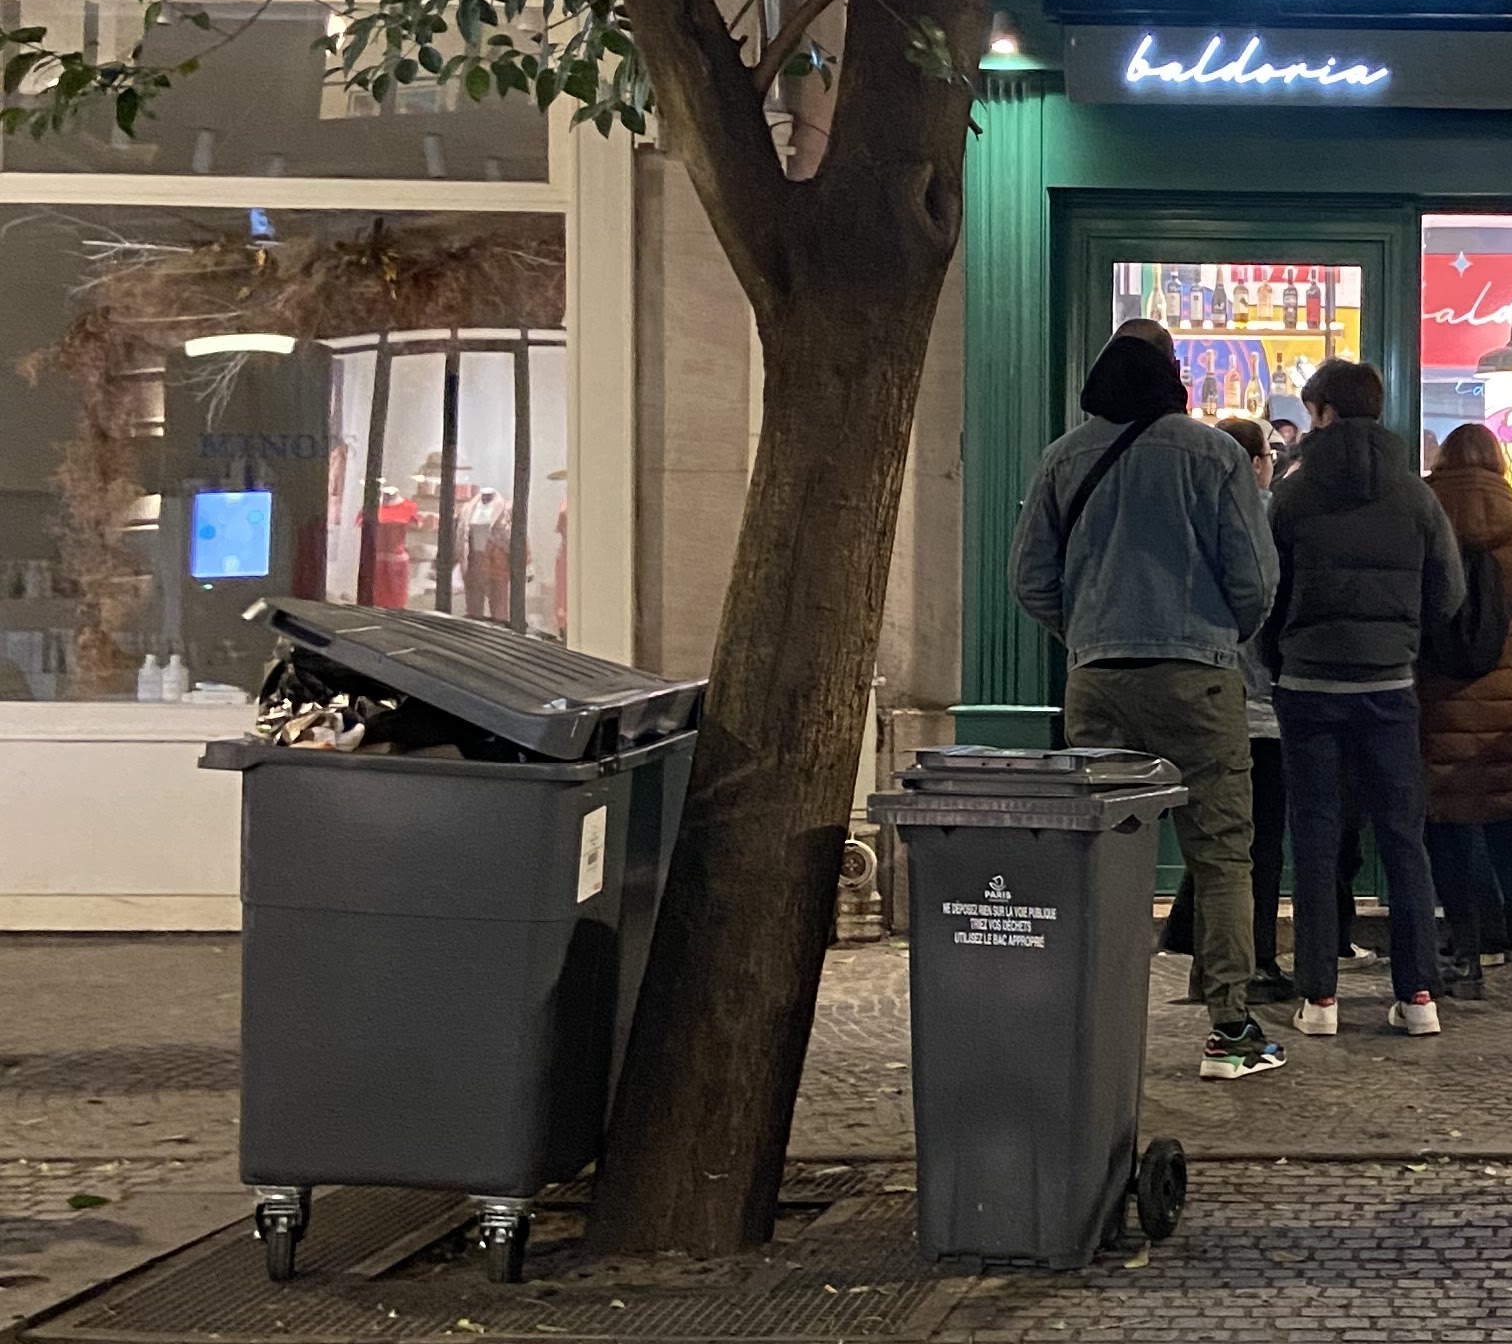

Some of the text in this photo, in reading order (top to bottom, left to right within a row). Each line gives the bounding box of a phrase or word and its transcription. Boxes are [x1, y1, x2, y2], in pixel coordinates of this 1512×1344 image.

[1126, 34, 1389, 85] baldoria
[984, 890, 1012, 899] PARIS
[993, 905, 1004, 917] SUR
[1005, 906, 1013, 917] LA
[1014, 906, 1028, 918] VOIE
[1028, 907, 1057, 920] PUBLIQUE
[970, 918, 988, 930] TRIEZ
[988, 919, 1001, 931] VOS
[954, 932, 983, 944] UTILISEZ
[983, 933, 992, 945] LE
[993, 933, 1007, 946] BAC
